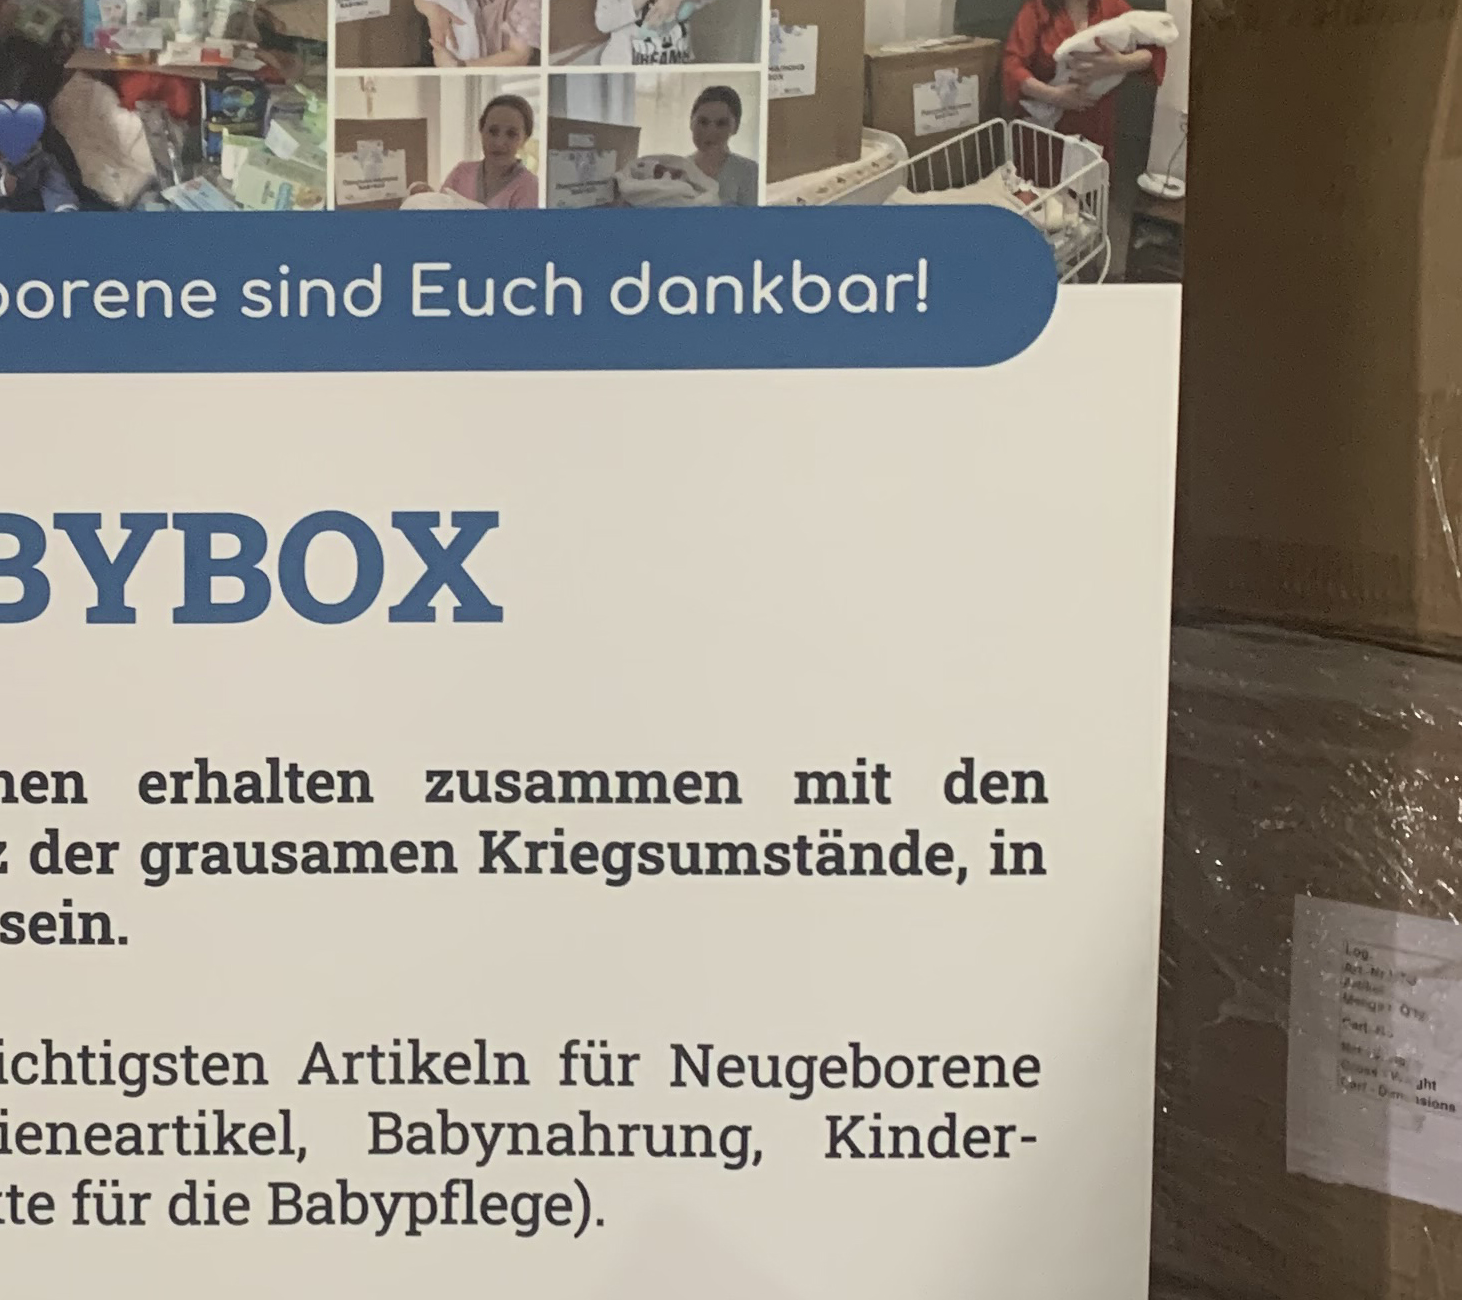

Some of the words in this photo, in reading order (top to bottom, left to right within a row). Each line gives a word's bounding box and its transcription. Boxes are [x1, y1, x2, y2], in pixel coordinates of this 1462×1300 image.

[242, 263, 381, 317] sind
[413, 262, 581, 316] Euch
[611, 258, 927, 315] dankbar!
[139, 757, 374, 804] erhalten
[425, 770, 742, 804] zusammen
[794, 757, 891, 805] mit
[944, 757, 1048, 804] den
[30, 828, 119, 875] der
[141, 840, 458, 887] grausamen
[479, 828, 967, 887] Kriegsumstände,
[990, 829, 1047, 875] in
[0, 899, 127, 945] sein.
[298, 1038, 530, 1085] Artikeln
[559, 1039, 640, 1086] für
[670, 1042, 1040, 1100] Neugeborene
[368, 1108, 762, 1170] Babynahrung,
[825, 1112, 1036, 1159] Kinder-
[72, 1179, 151, 1226] für
[169, 1179, 250, 1226] die
[268, 1178, 604, 1238] Babypflege).
